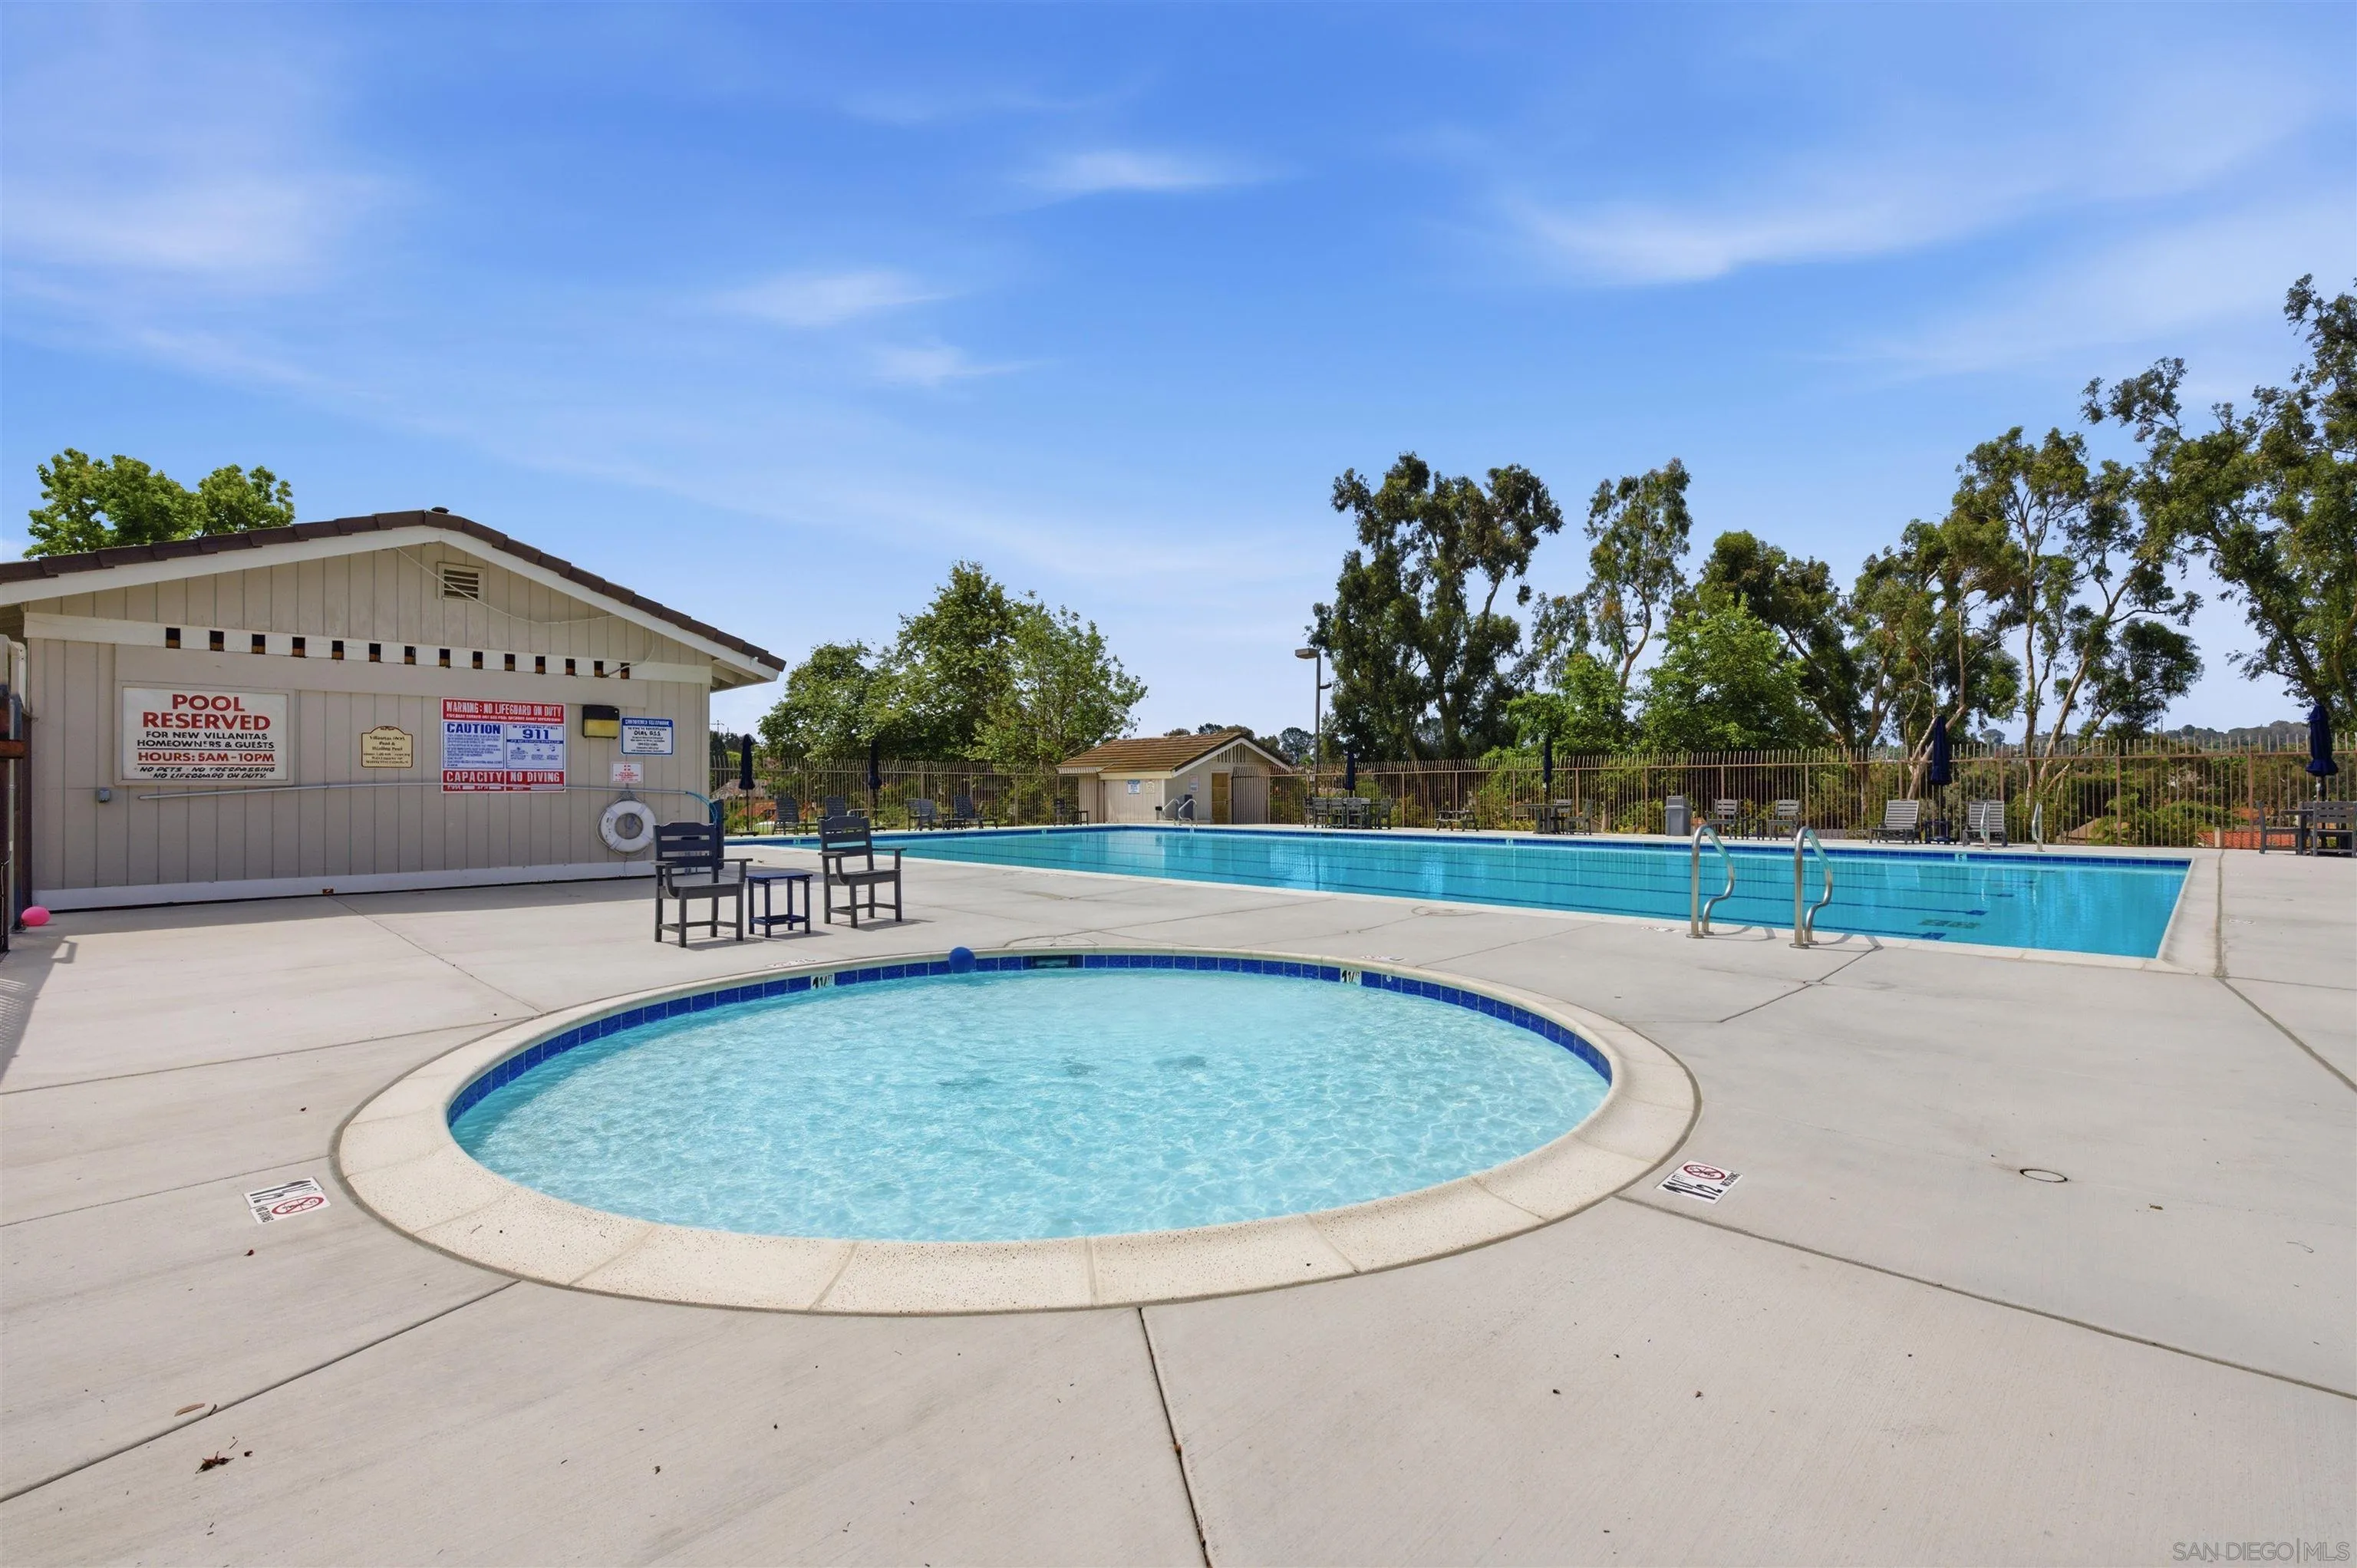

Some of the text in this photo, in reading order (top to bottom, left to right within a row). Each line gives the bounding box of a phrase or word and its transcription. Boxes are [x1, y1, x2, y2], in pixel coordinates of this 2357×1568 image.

[172, 693, 246, 712] POOL
[483, 703, 493, 714] NO
[496, 703, 531, 716] LIFEGUARD
[534, 705, 542, 716] ON
[545, 706, 562, 717] DUTY
[143, 712, 271, 730] RESERVED
[447, 723, 501, 735] CAUTION
[522, 729, 549, 740] 911
[204, 732, 268, 740] VILLANITAS
[138, 753, 196, 762] HOURS:
[447, 771, 502, 782] CAPACITY
[509, 772, 560, 782] NO DIVING
